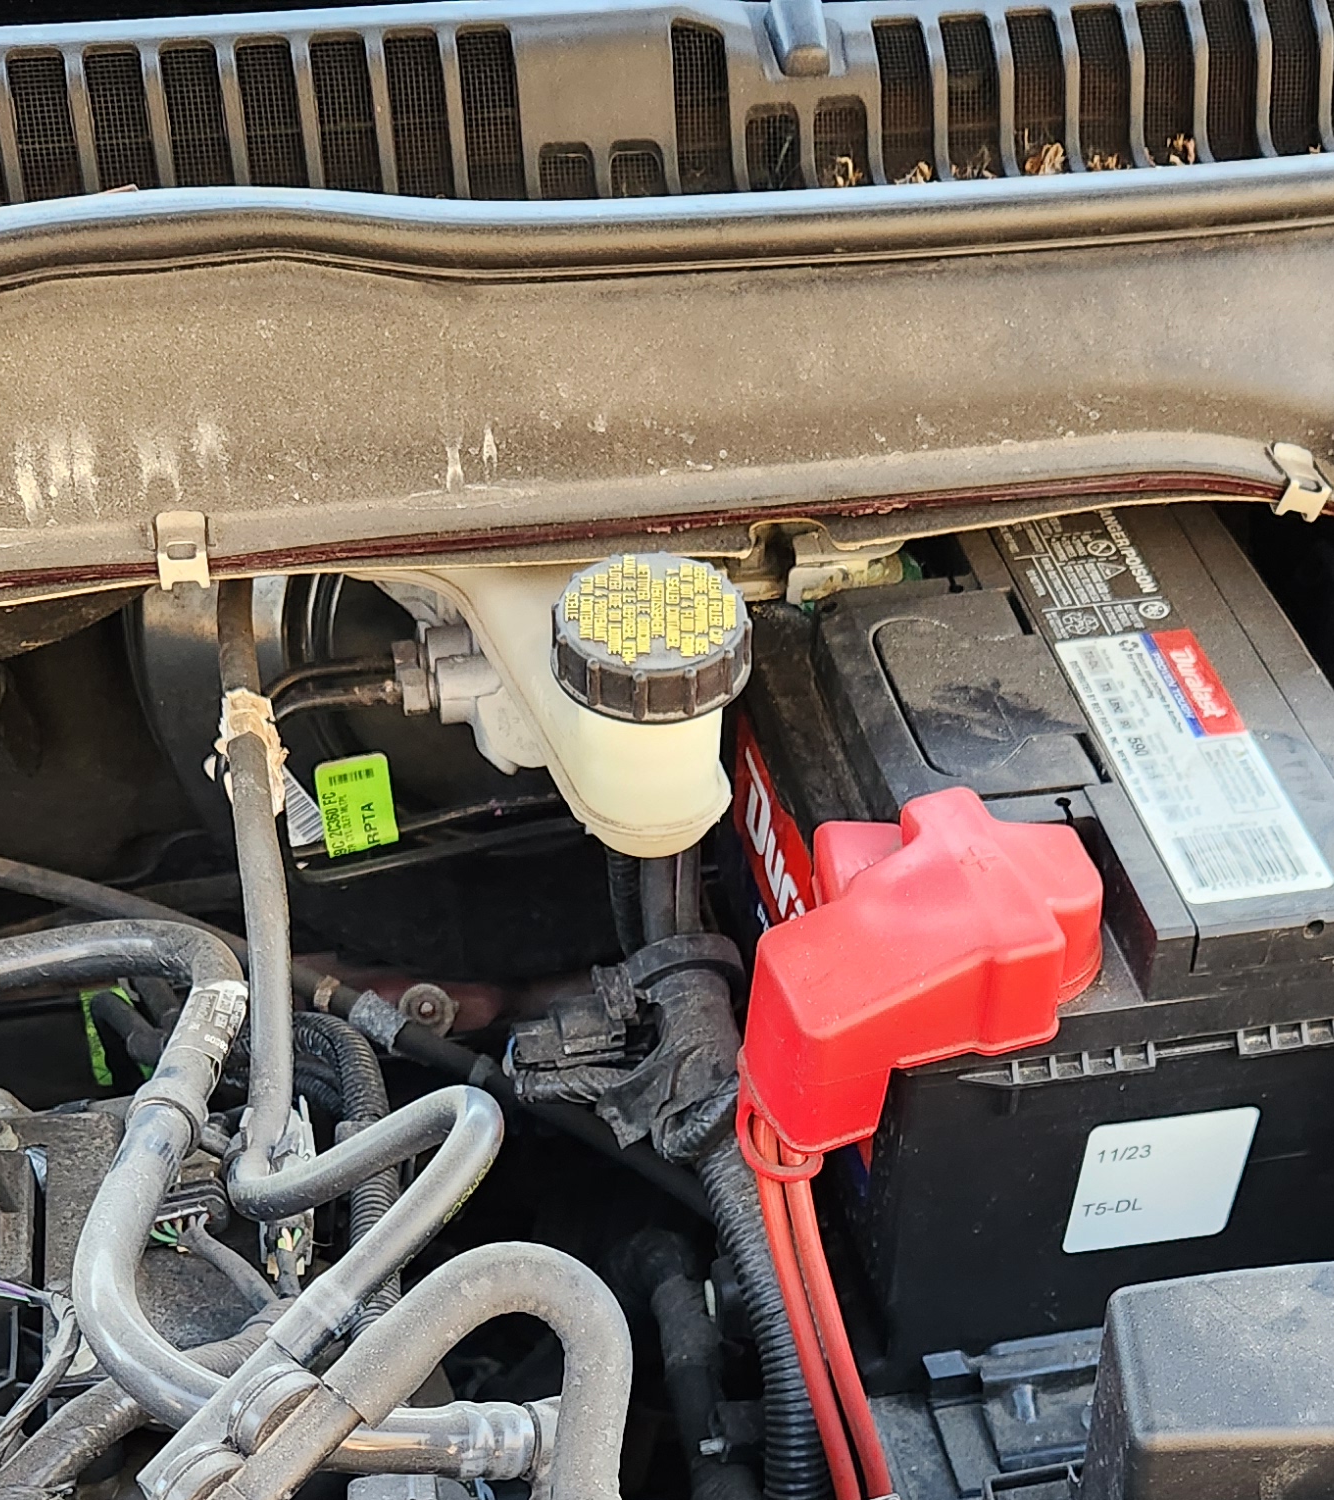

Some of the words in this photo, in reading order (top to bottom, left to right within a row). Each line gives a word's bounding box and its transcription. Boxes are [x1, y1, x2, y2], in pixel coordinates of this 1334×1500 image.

[1099, 507, 1158, 594] ANGER/POISON
[1169, 646, 1228, 718] Duralast
[1126, 734, 1150, 756] 590
[1097, 1144, 1152, 1164] 11/23
[1082, 1198, 1143, 1218] T5-DL
